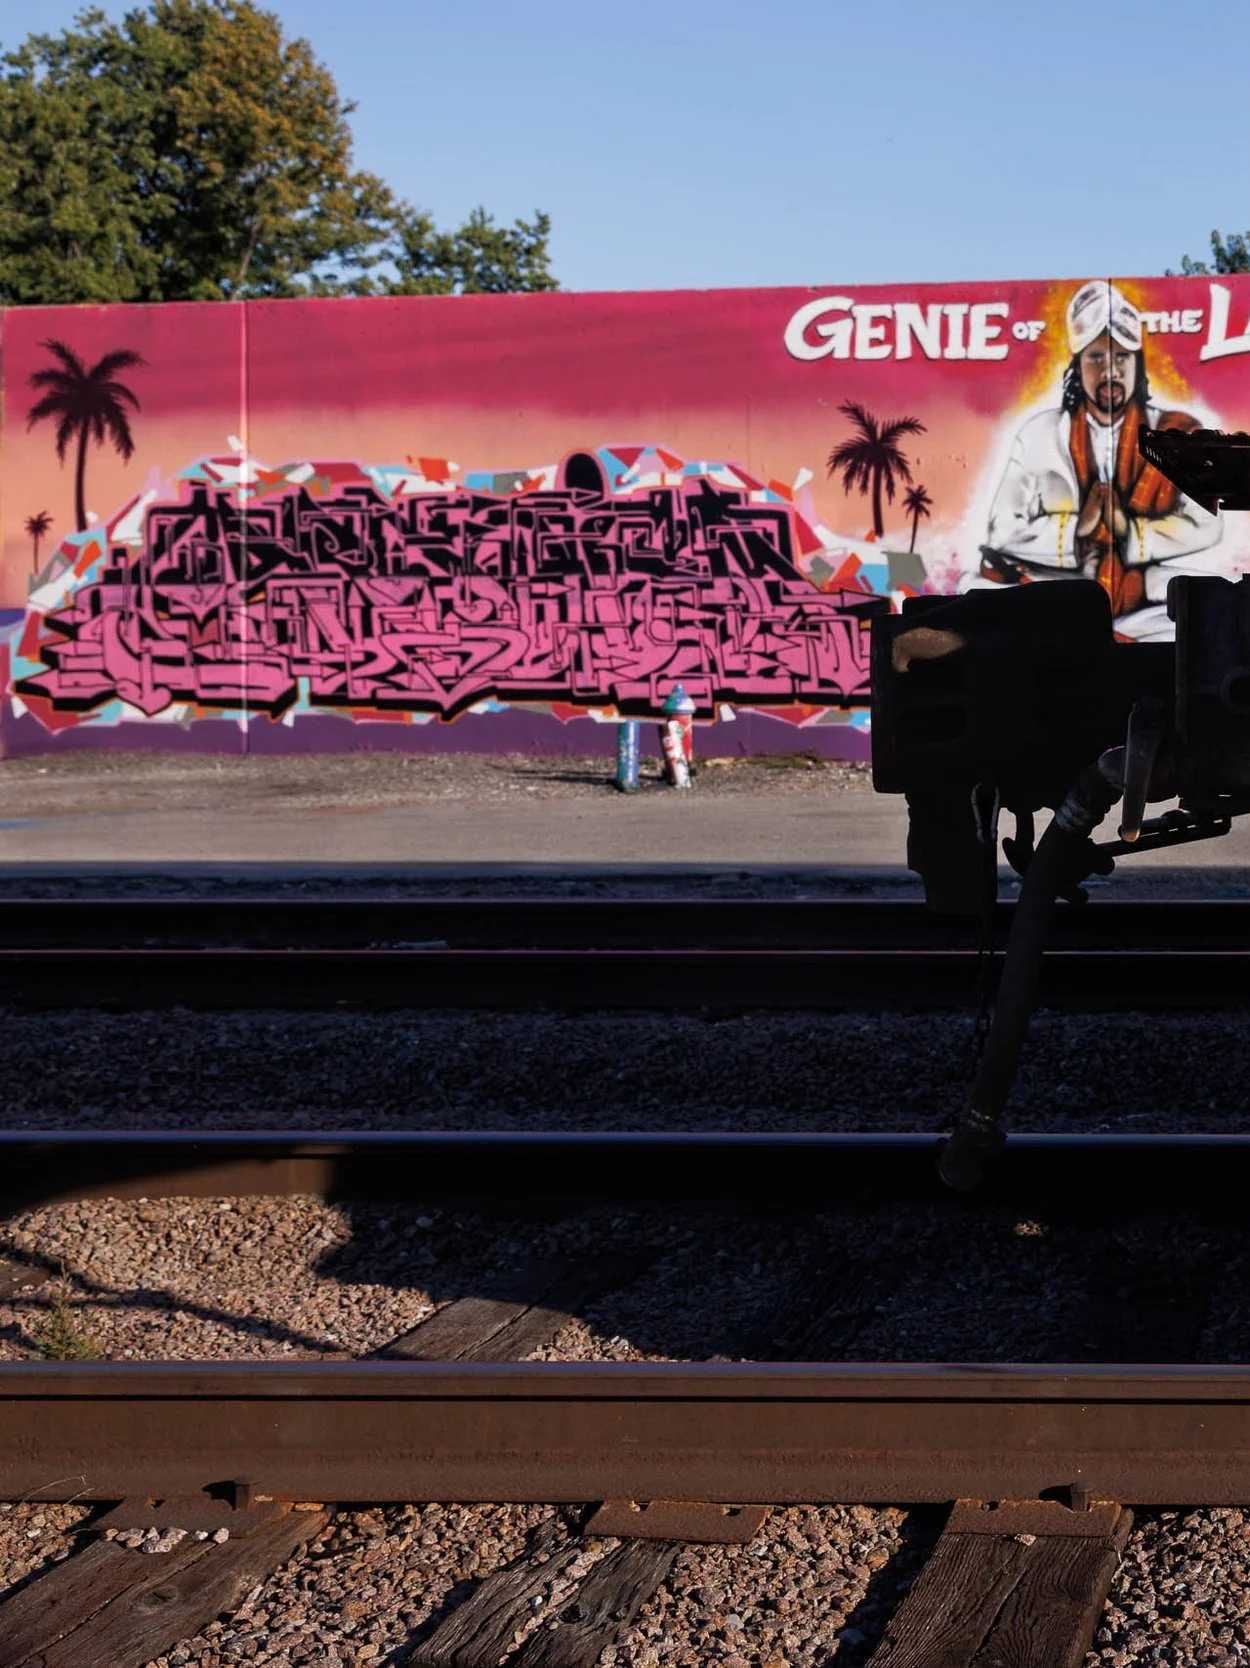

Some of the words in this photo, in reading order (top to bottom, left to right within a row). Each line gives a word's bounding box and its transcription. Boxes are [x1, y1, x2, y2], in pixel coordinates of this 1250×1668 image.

[783, 295, 1009, 361] GENIE
[1012, 320, 1046, 342] OF
[1140, 308, 1204, 334] THE
